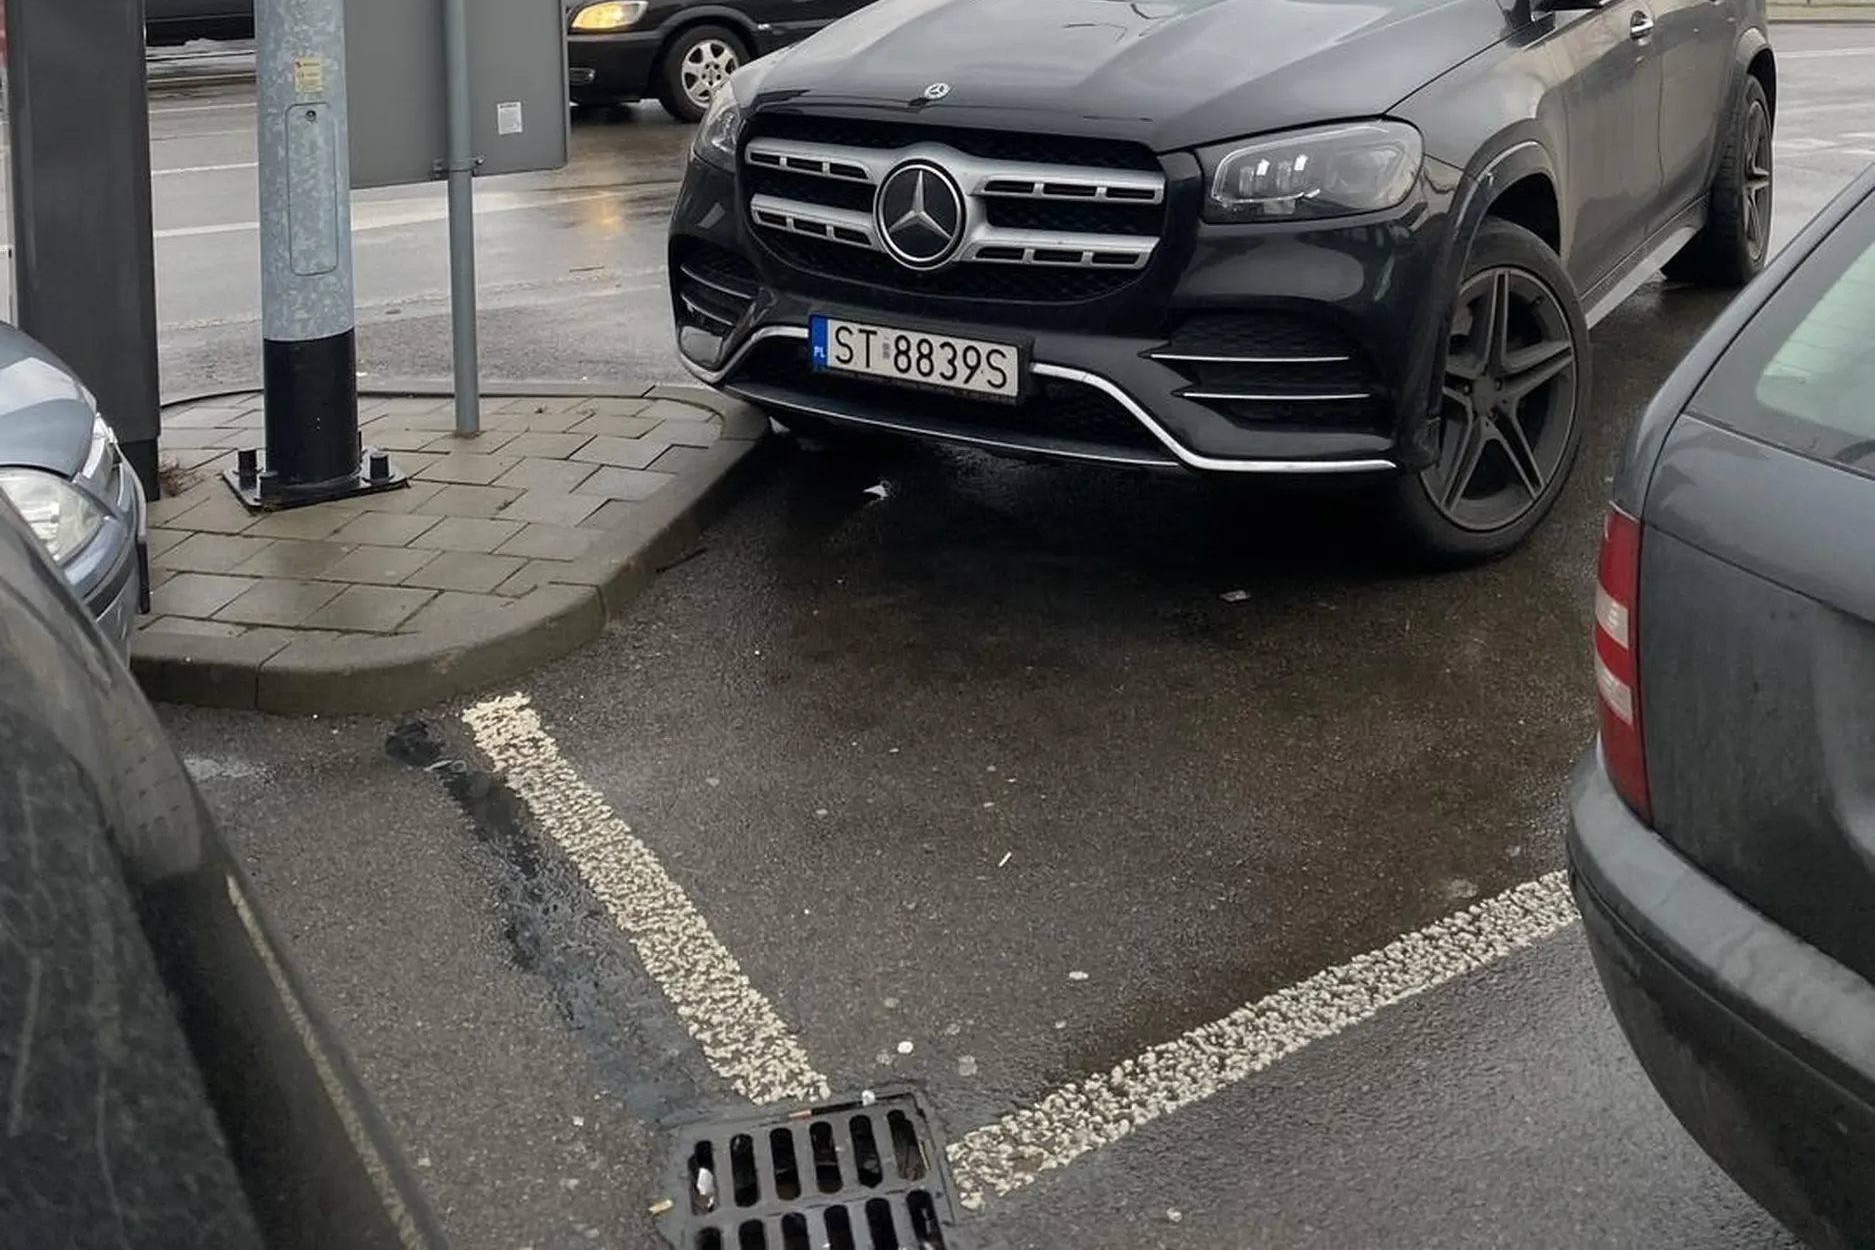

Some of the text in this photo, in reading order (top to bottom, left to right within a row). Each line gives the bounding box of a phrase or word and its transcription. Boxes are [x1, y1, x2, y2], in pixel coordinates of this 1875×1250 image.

[813, 346, 826, 358] PL
[835, 326, 877, 368] ST
[893, 335, 1008, 389] 8839S
